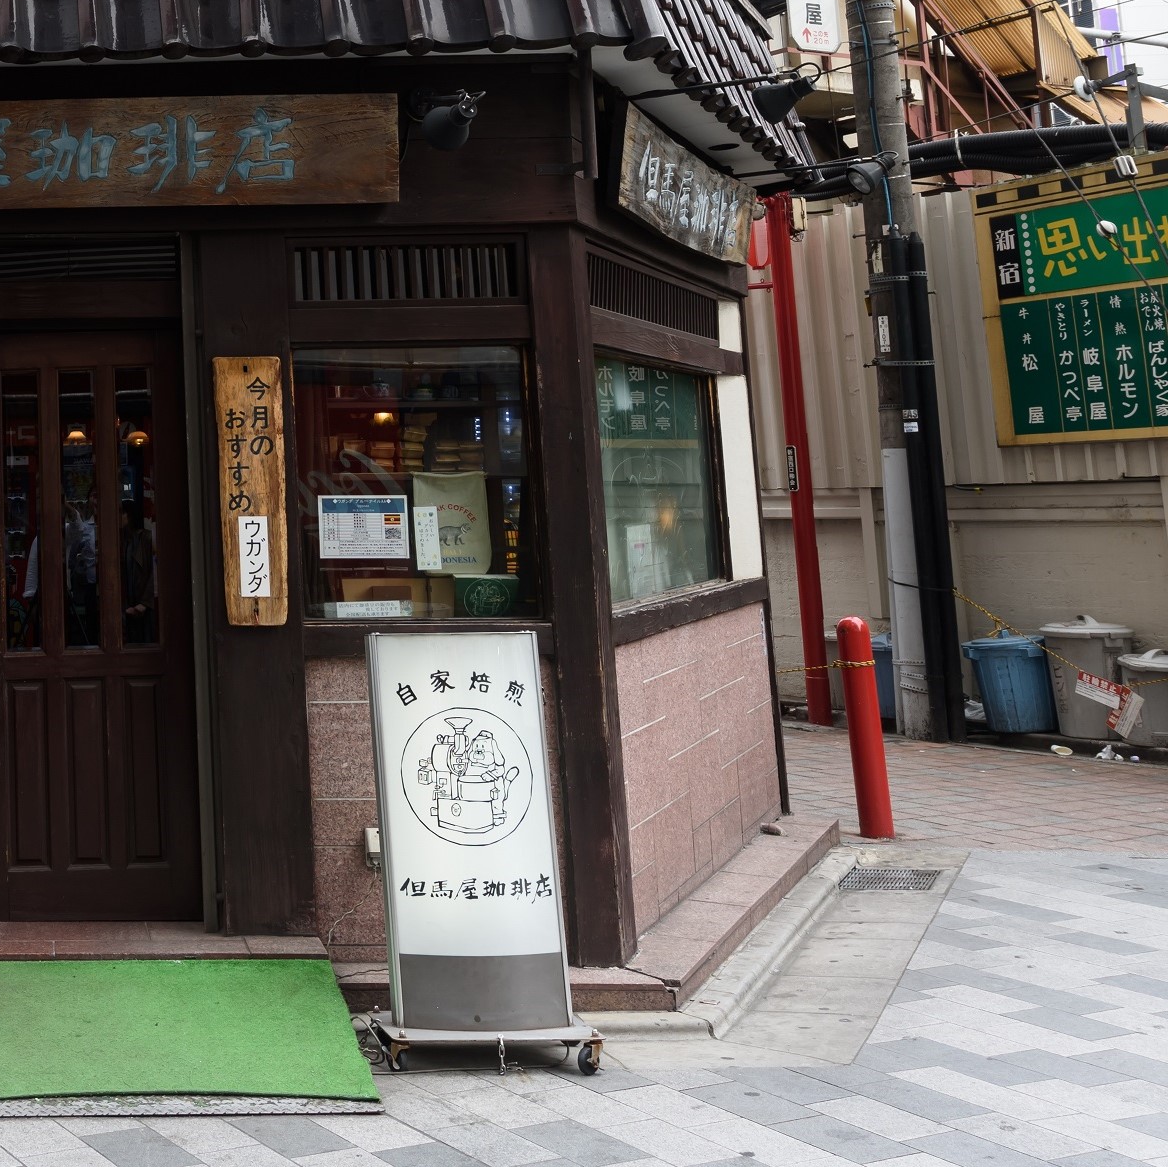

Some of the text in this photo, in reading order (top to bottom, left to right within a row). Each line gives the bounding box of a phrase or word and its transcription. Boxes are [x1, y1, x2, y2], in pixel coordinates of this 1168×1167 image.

[639, 140, 740, 253] 但馬屋珈琲店
[995, 228, 1020, 285] 新宿
[1037, 216, 1168, 278] 思い出
[1019, 307, 1032, 345] 牛丼
[1055, 302, 1068, 341] やきとり
[1080, 299, 1093, 337] ラーメン
[1109, 295, 1127, 335] 情熱
[1140, 293, 1157, 332] おでん
[1022, 354, 1045, 424] 松屋
[1083, 348, 1108, 420] 岐阜屋
[1116, 344, 1138, 419] ホルモン
[246, 377, 274, 456] 今月の
[224, 407, 252, 513] おすすめ
[447, 503, 477, 523] COFFEE
[244, 520, 267, 594] ウガンダ
[395, 669, 525, 707] 自家焙煎
[400, 872, 553, 903] 但馬屋珈琲店
